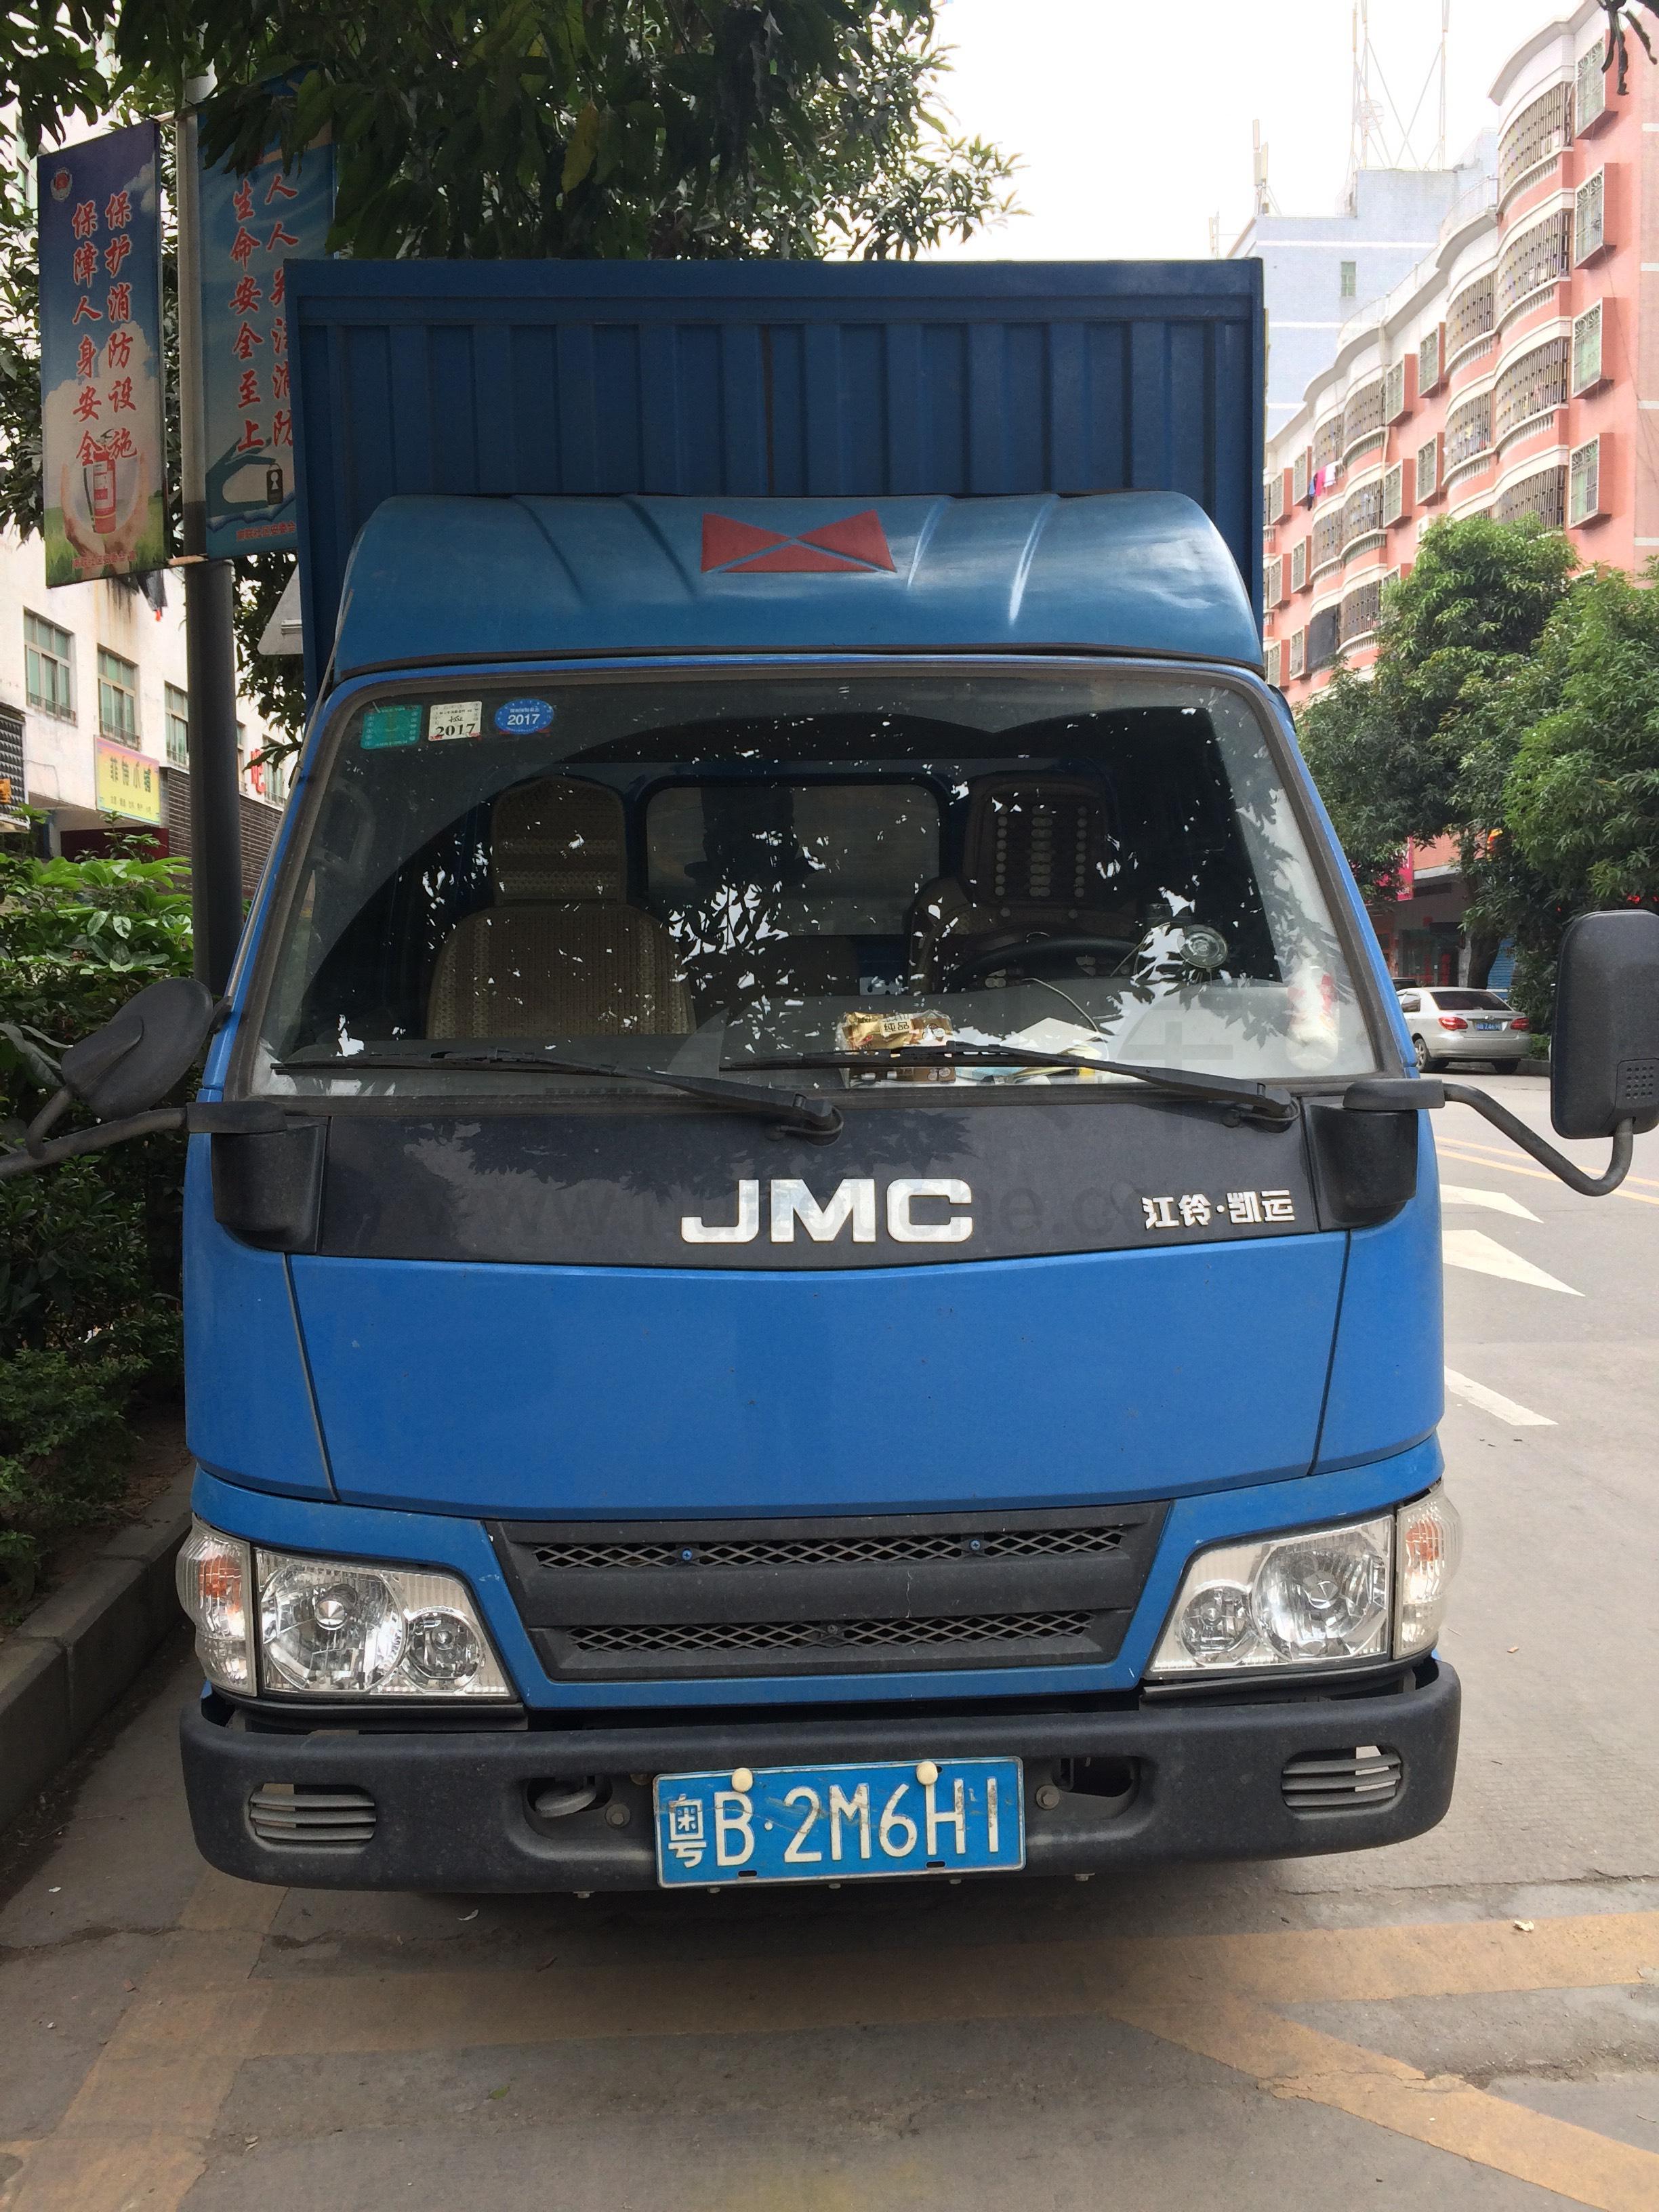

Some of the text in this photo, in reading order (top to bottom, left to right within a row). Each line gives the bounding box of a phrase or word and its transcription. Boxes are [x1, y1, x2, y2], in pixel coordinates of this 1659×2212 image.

[72, 200, 102, 468] 保障人身安全
[104, 190, 138, 459] 保护消防设施
[228, 178, 265, 453] 生命安全至上
[436, 723, 476, 736] 2017
[507, 714, 541, 726] 2017
[680, 1178, 973, 1243] JMC
[1141, 1189, 1295, 1230] 江铃·凯运
